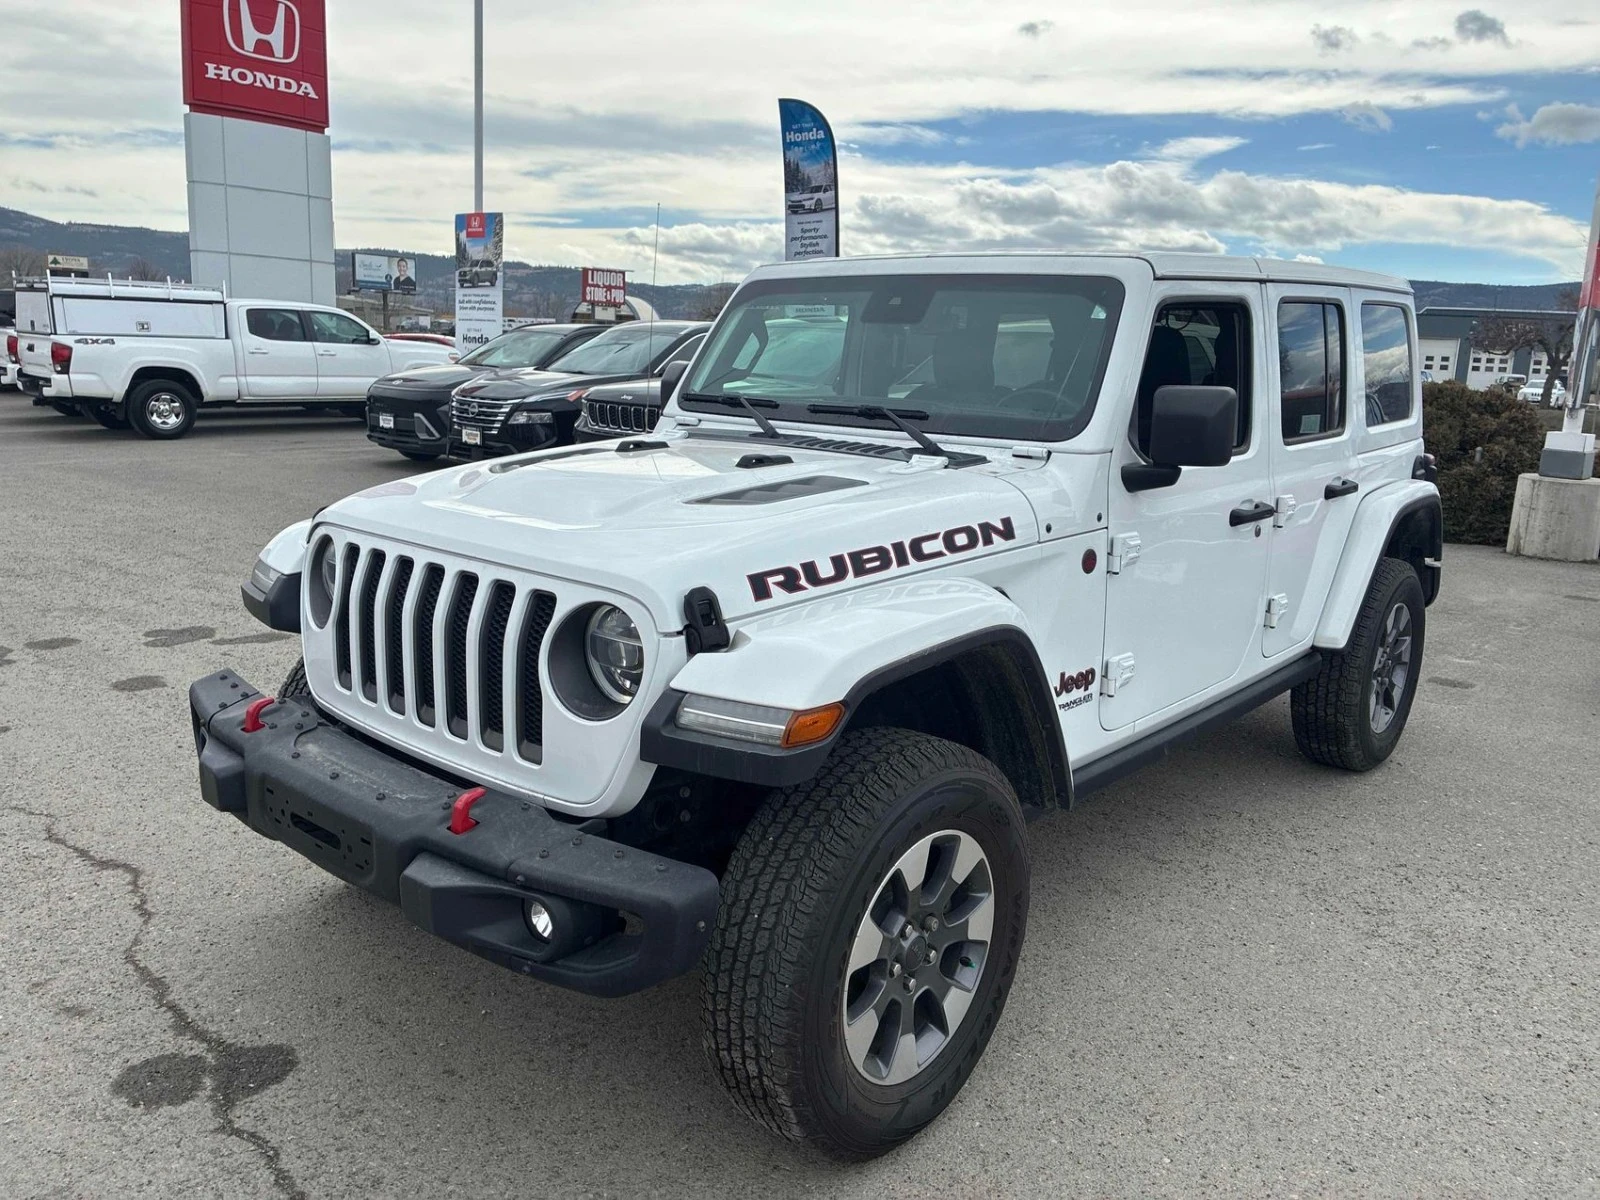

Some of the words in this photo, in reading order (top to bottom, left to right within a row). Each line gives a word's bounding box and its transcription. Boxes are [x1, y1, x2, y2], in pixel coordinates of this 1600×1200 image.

[204, 62, 319, 99] HONDA
[785, 127, 826, 143] Honda
[800, 241, 820, 249] Stylish
[588, 270, 624, 287] LIQUOR
[585, 286, 607, 302] STORE
[606, 290, 611, 301] &
[611, 288, 625, 303] PUB
[462, 333, 490, 344] Honda
[746, 516, 1017, 602] RUBICON
[1053, 667, 1096, 698] Jeep
